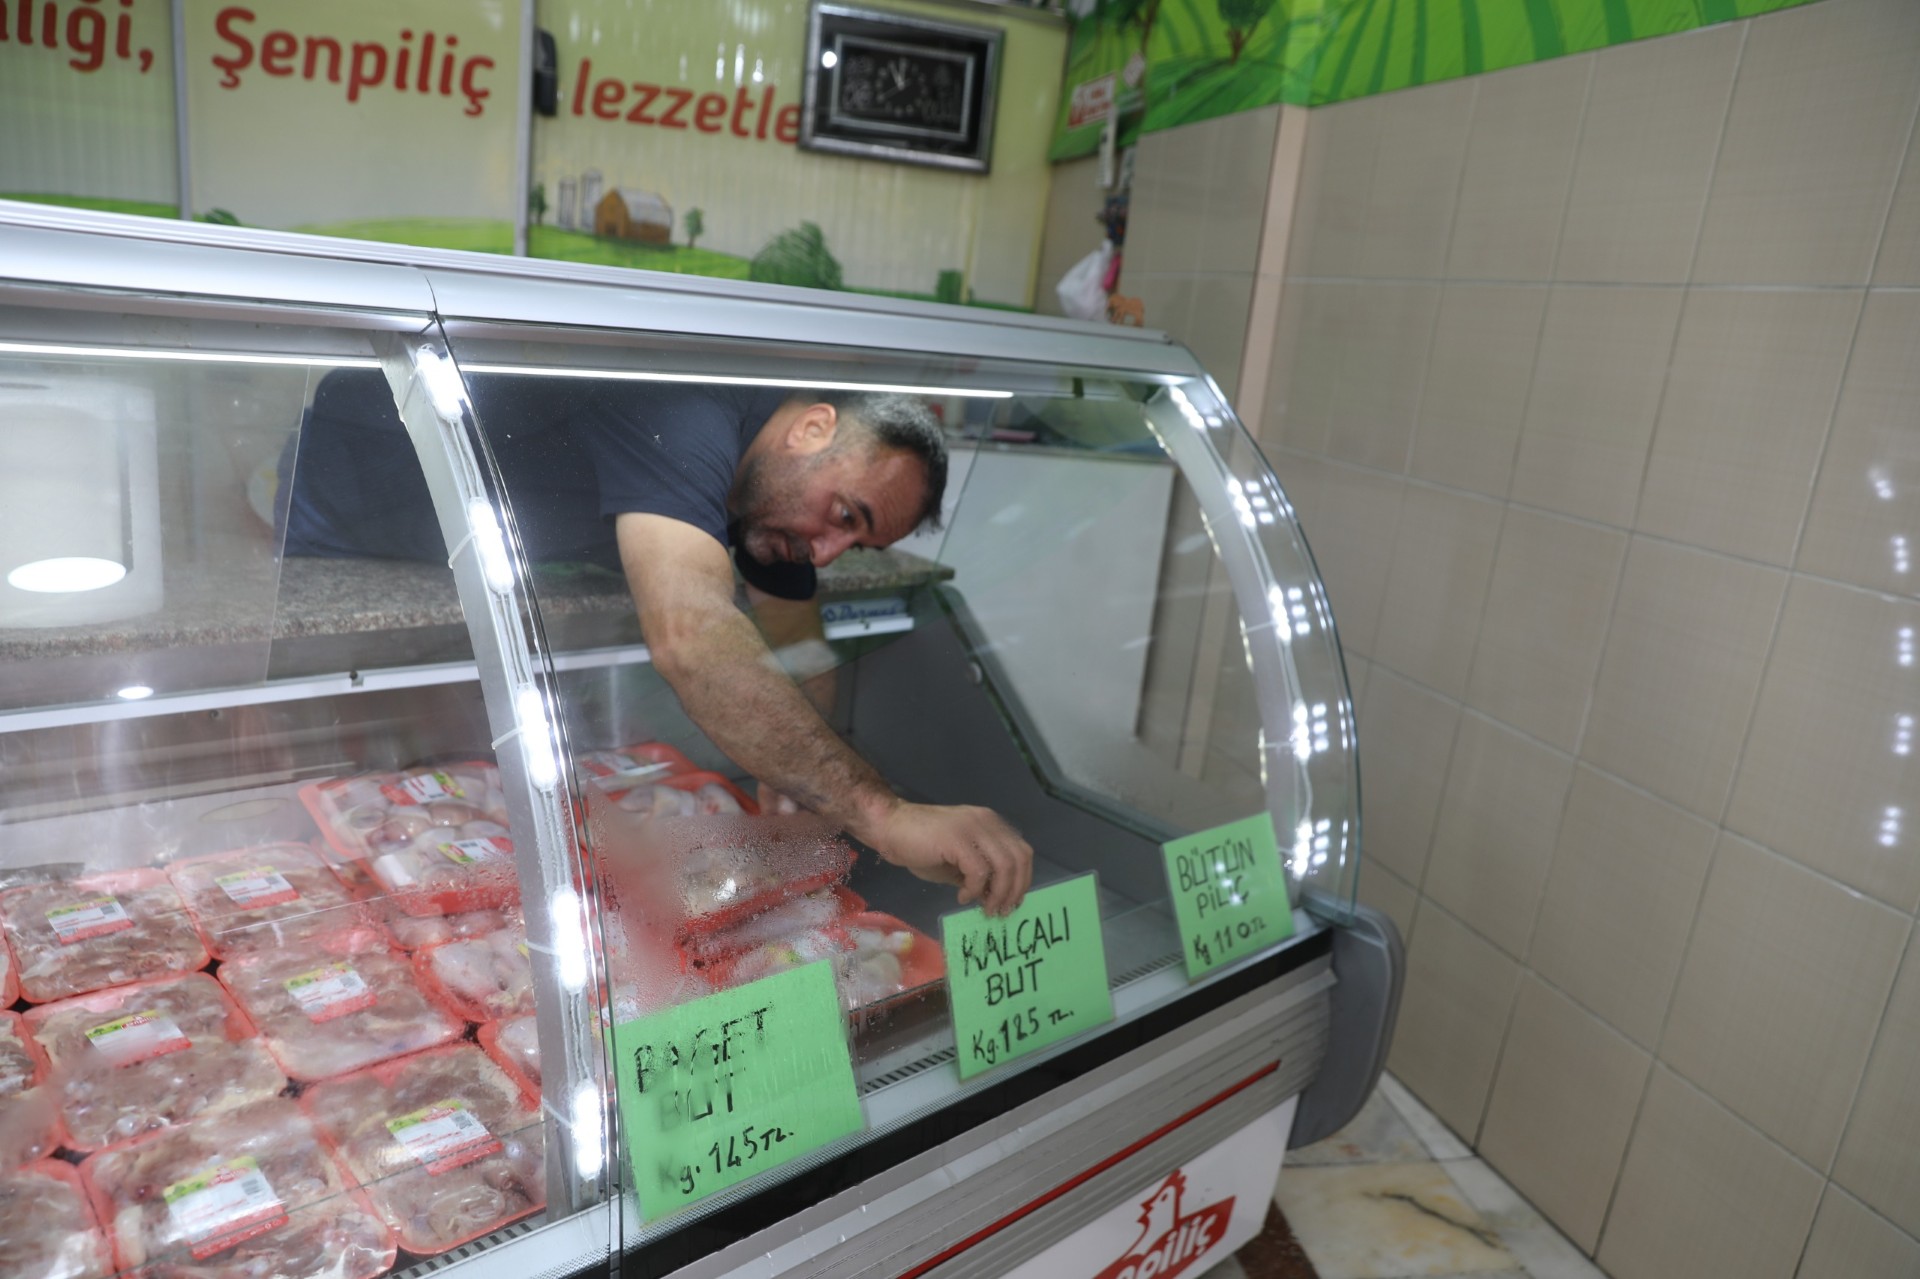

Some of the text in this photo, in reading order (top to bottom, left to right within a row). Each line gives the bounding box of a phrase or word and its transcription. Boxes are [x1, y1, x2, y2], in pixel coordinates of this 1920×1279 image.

[211, 6, 496, 117] Şenpiliç
[571, 57, 801, 145] lezzetle
[1176, 837, 1256, 893] BÜTÜN
[961, 905, 1071, 977] KALÇALI
[985, 957, 1045, 1007] BUT
